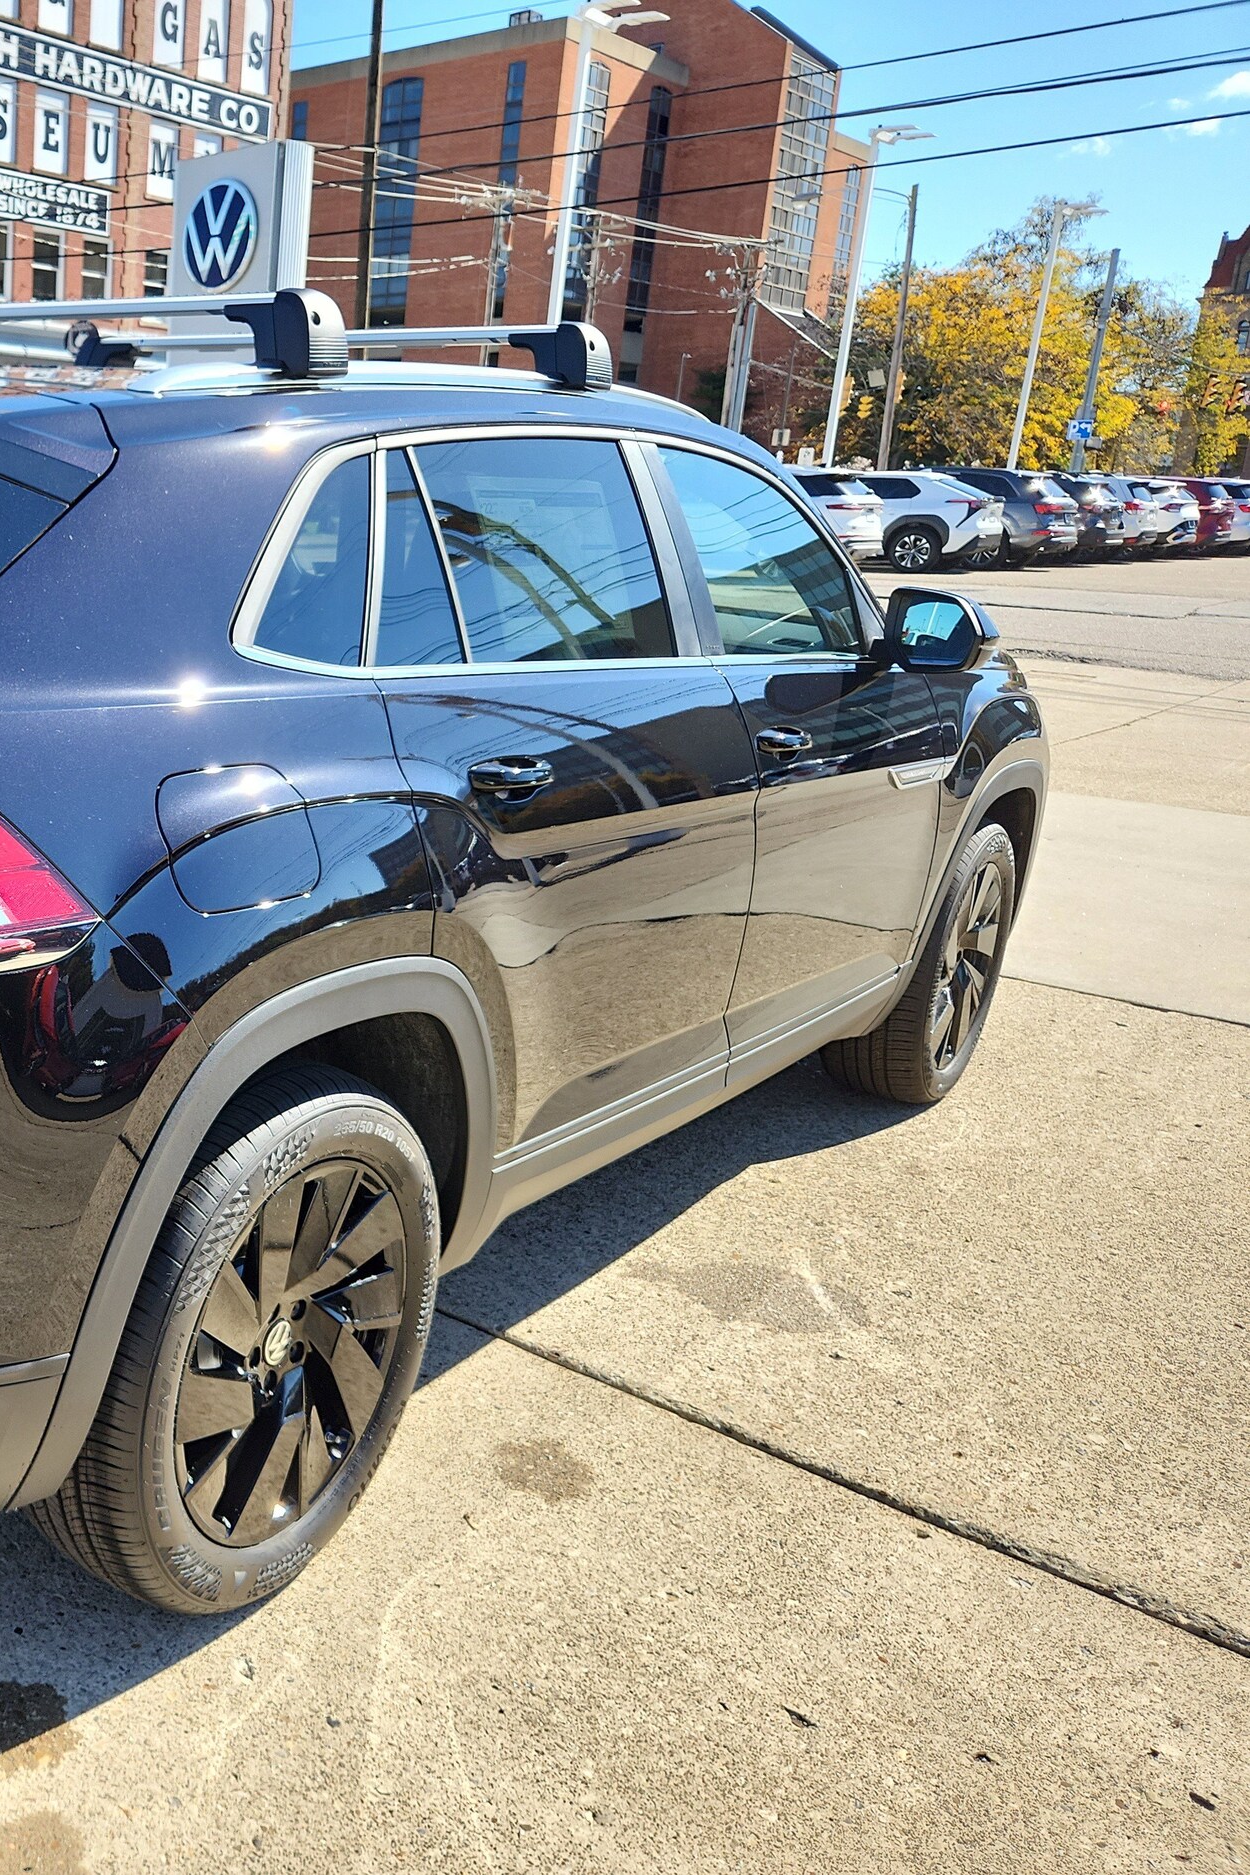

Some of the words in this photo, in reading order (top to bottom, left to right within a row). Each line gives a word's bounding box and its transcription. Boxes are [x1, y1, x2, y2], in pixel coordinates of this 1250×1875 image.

[34, 42, 211, 121] HARDWARE
[219, 98, 260, 134] CO
[374, 1122, 395, 1143] R20
